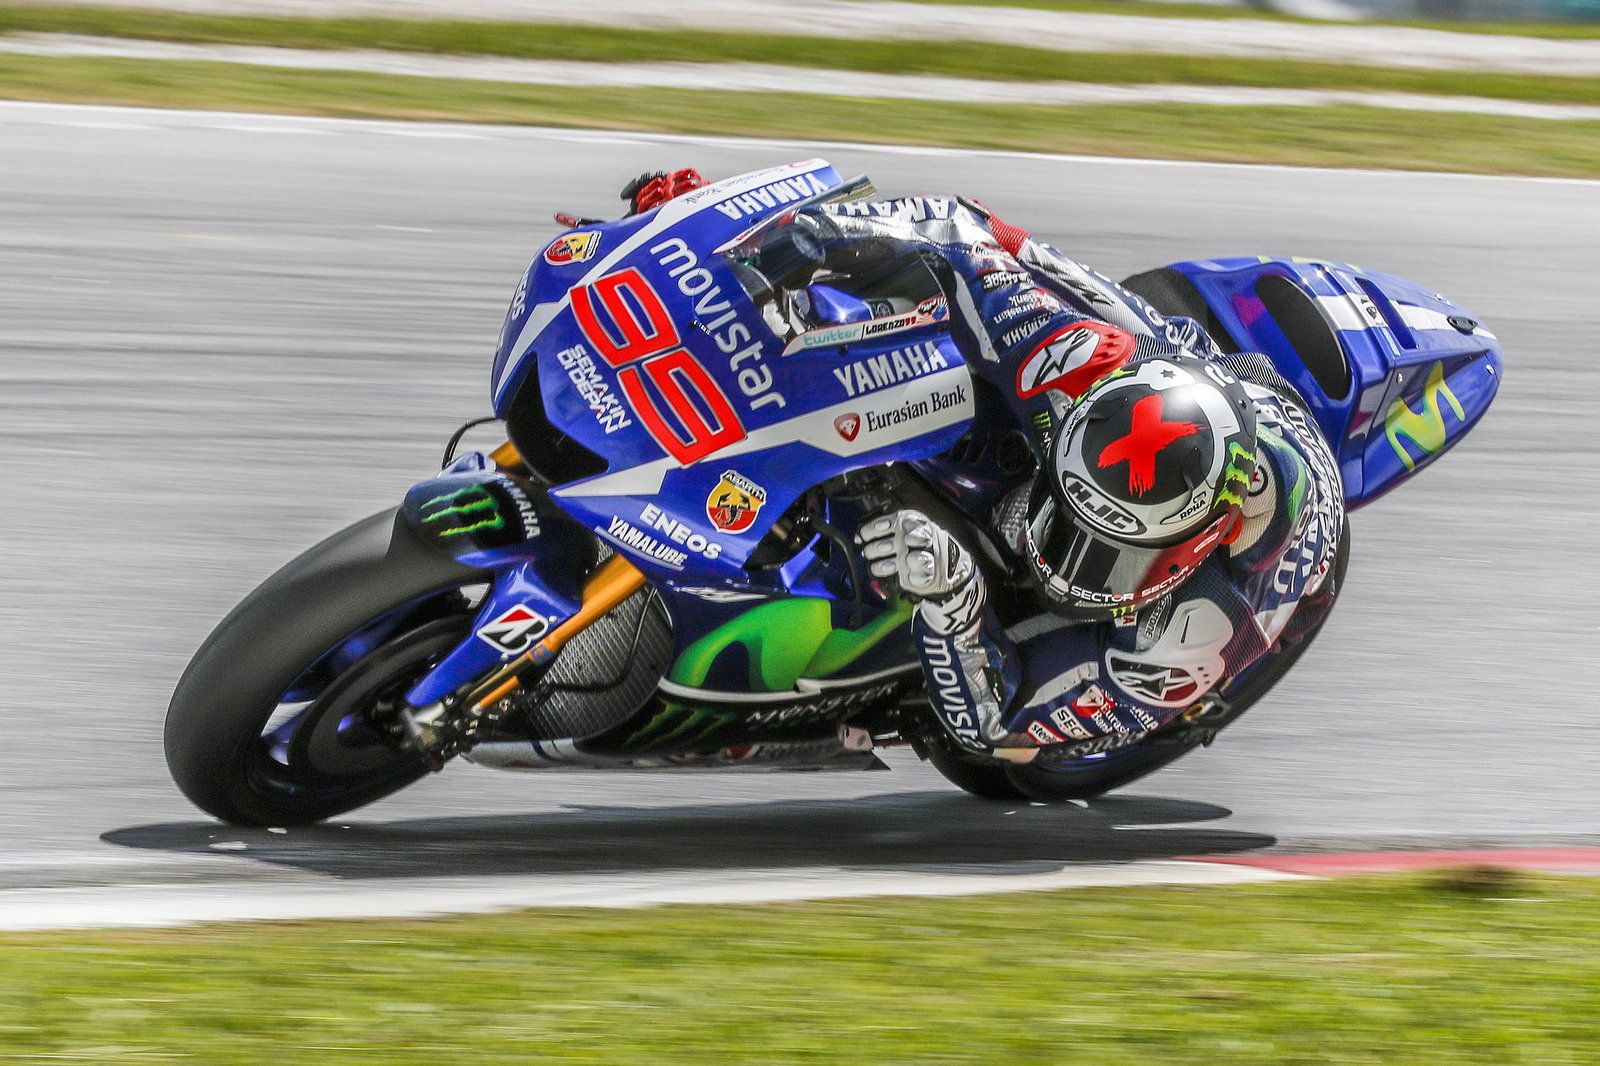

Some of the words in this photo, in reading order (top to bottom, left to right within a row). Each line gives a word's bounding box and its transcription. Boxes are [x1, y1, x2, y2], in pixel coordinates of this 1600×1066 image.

[714, 172, 830, 221] YAMAHA
[650, 237, 786, 411] movistar
[803, 327, 860, 346] twitter
[570, 267, 748, 466] 99
[570, 343, 632, 429] SEMAKIN
[833, 340, 949, 397] YAMAHA
[568, 366, 619, 434] DEPAN
[865, 400, 929, 433] Eurasian
[930, 384, 967, 412] Bank
[1067, 480, 1136, 530] HJC
[1179, 498, 1206, 521] RPHA
[607, 515, 689, 566] YAMALUBE
[639, 502, 722, 560] ENEOS
[1070, 585, 1135, 602] SECTOR
